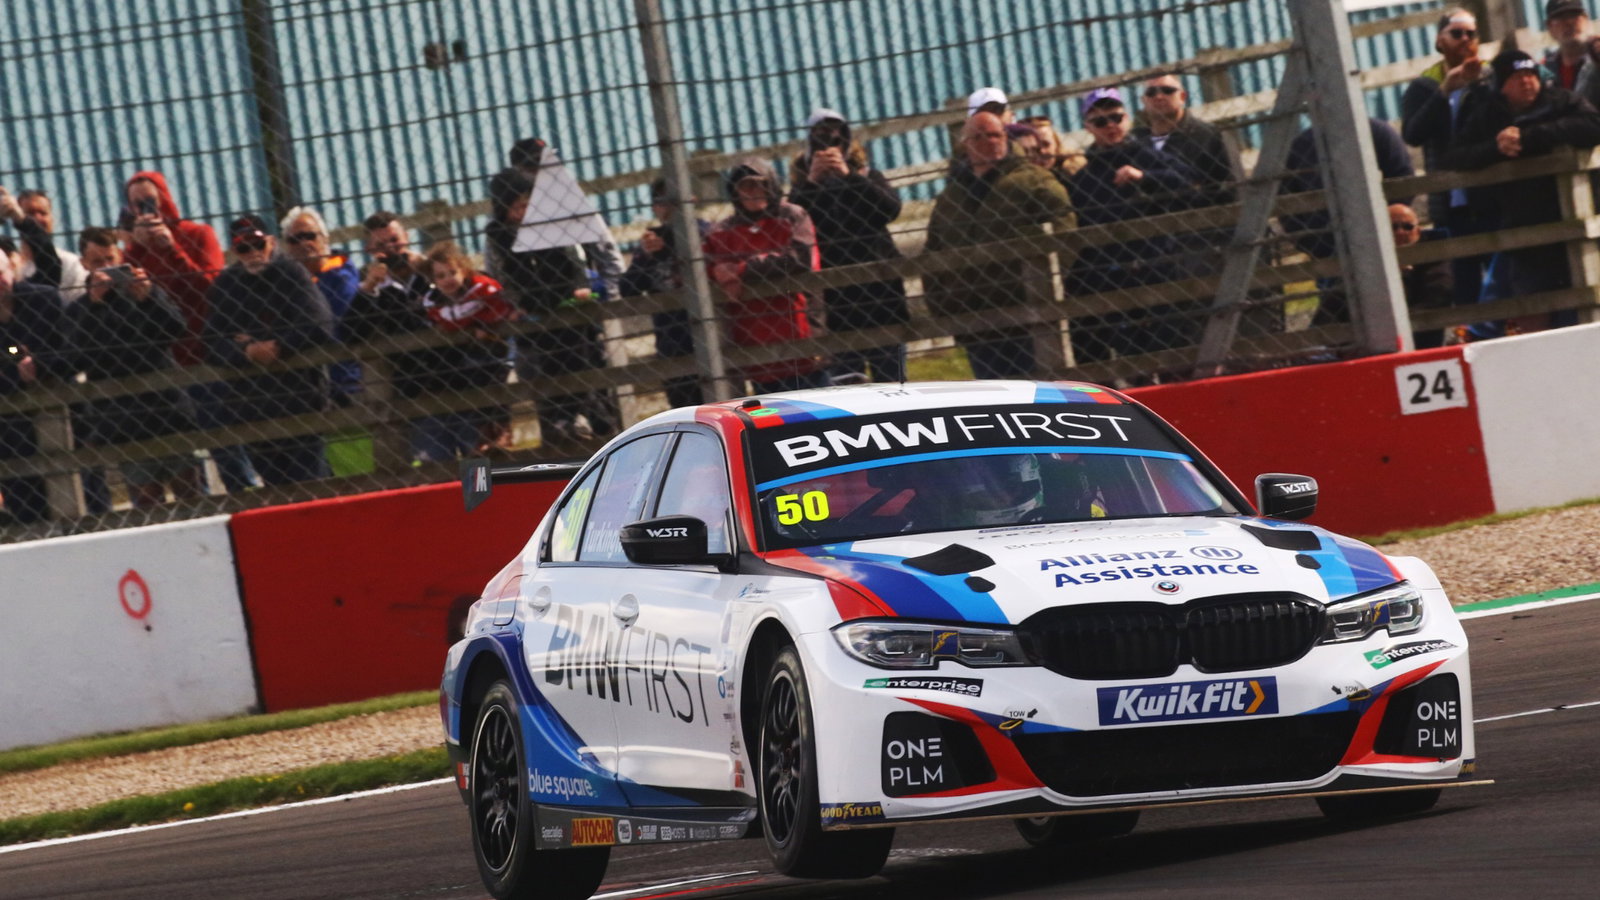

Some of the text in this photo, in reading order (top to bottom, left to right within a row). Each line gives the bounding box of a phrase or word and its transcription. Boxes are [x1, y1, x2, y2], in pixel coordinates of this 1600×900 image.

[1407, 370, 1454, 404] 24
[1274, 482, 1312, 494] WSR
[776, 490, 830, 525] 50
[646, 527, 688, 538] WSR
[1040, 549, 1184, 571] Allianz
[1055, 561, 1260, 588] Assistance
[1372, 641, 1451, 665] enterprise
[868, 679, 981, 693] enterprise
[1009, 710, 1025, 718] TOW
[1417, 701, 1457, 720] ONE
[1418, 728, 1457, 747] PLM
[887, 738, 943, 760] ONE
[890, 765, 944, 786] PLM
[571, 820, 615, 843] AUTOCAR
